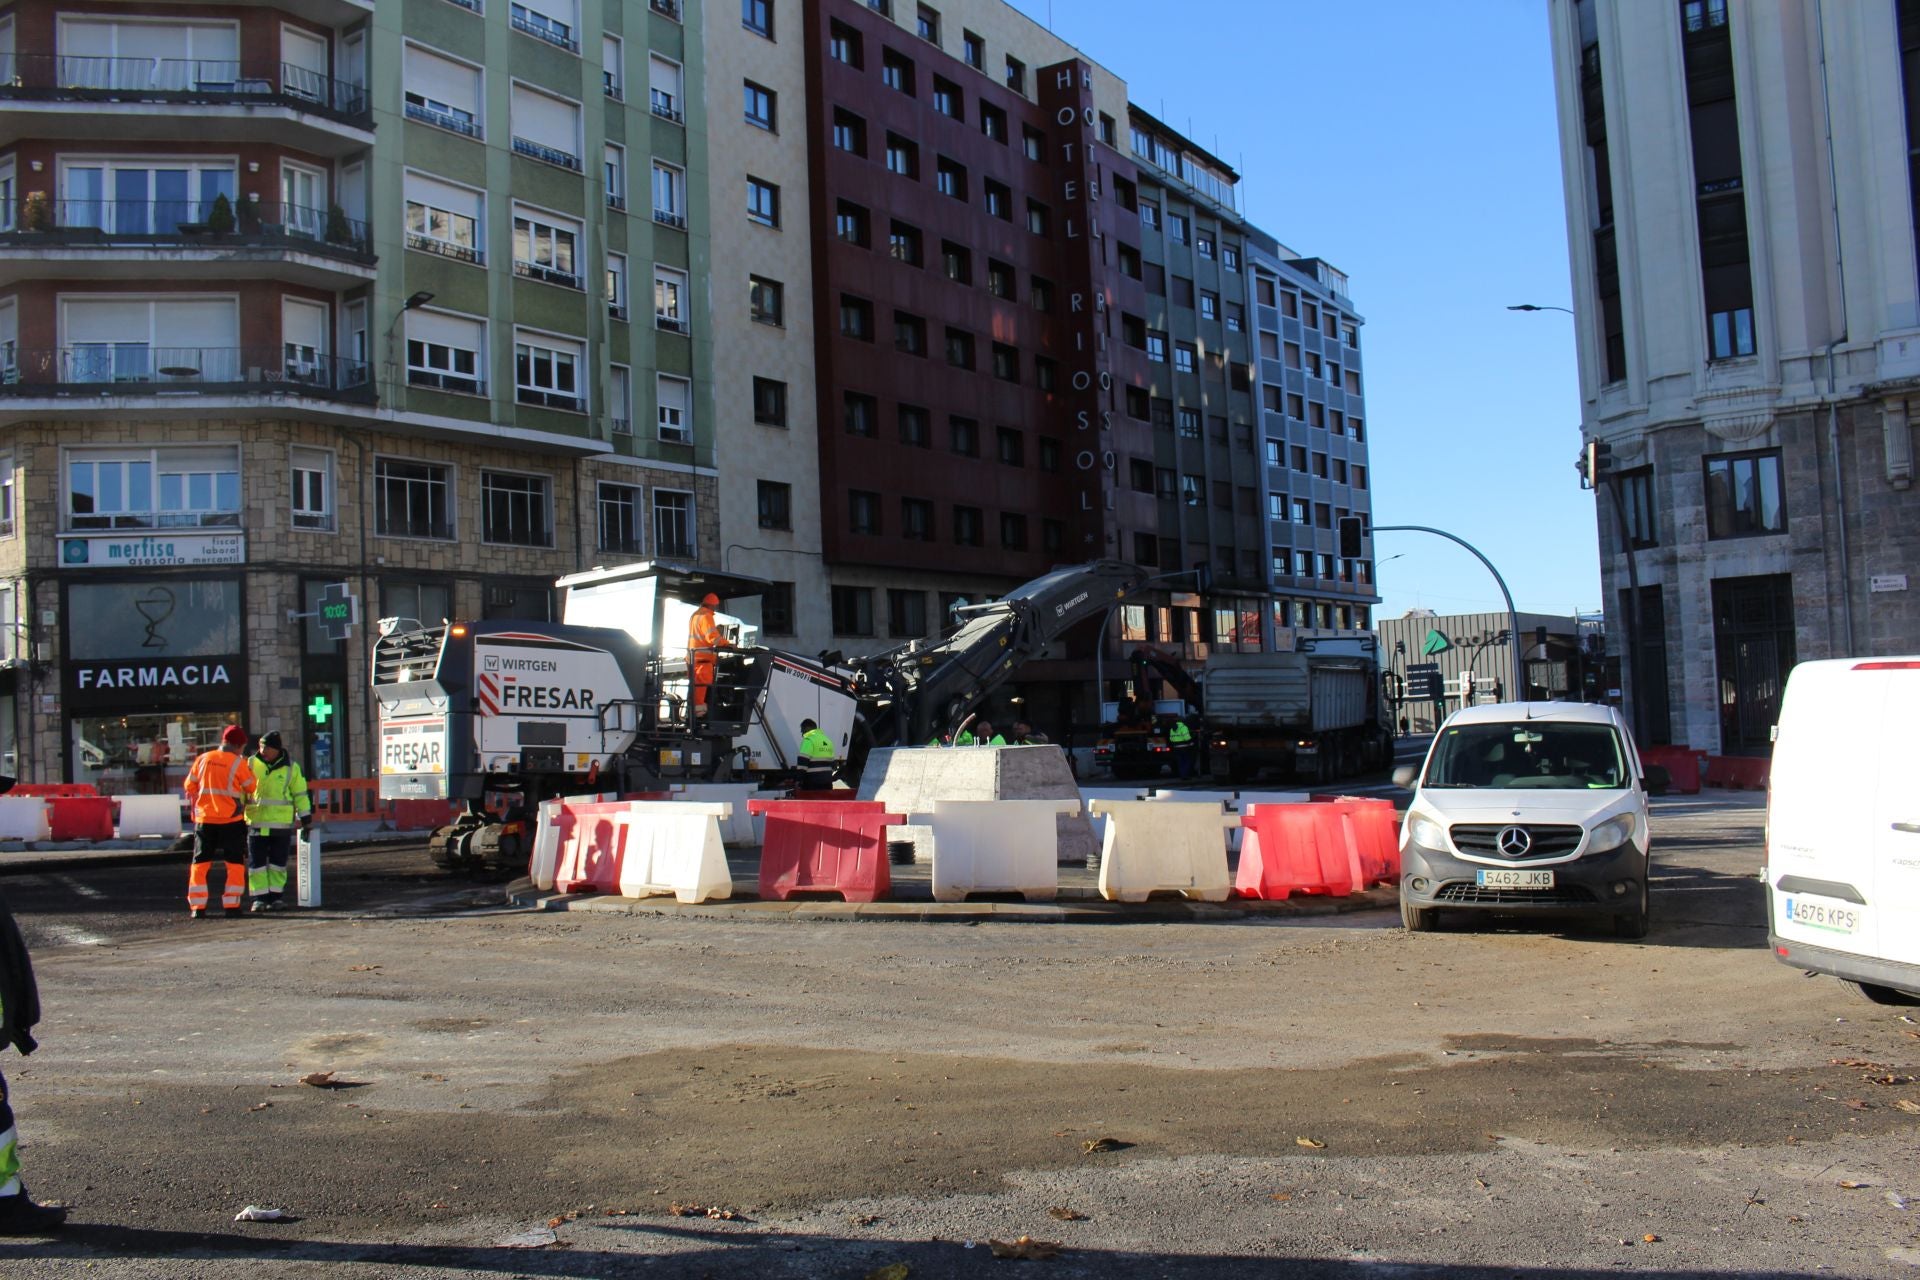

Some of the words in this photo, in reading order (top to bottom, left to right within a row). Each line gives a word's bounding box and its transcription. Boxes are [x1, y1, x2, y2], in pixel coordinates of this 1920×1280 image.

[1057, 69, 1079, 238] HOTEL
[108, 537, 174, 558] merfisa
[212, 536, 239, 545] fiscal
[202, 545, 239, 554] laboral
[129, 555, 185, 565] asesoria
[192, 555, 240, 564] mercantil
[502, 659, 557, 672] WIRTGEN
[78, 664, 231, 689] FARMACIA
[503, 685, 594, 710] FRESAR
[385, 741, 440, 765] FRESAR
[400, 783, 428, 794] WIRTGEN
[1486, 871, 1521, 886] 5462
[1525, 871, 1552, 886] JKB
[1793, 902, 1825, 923] 4676
[1827, 908, 1855, 929] KPS
